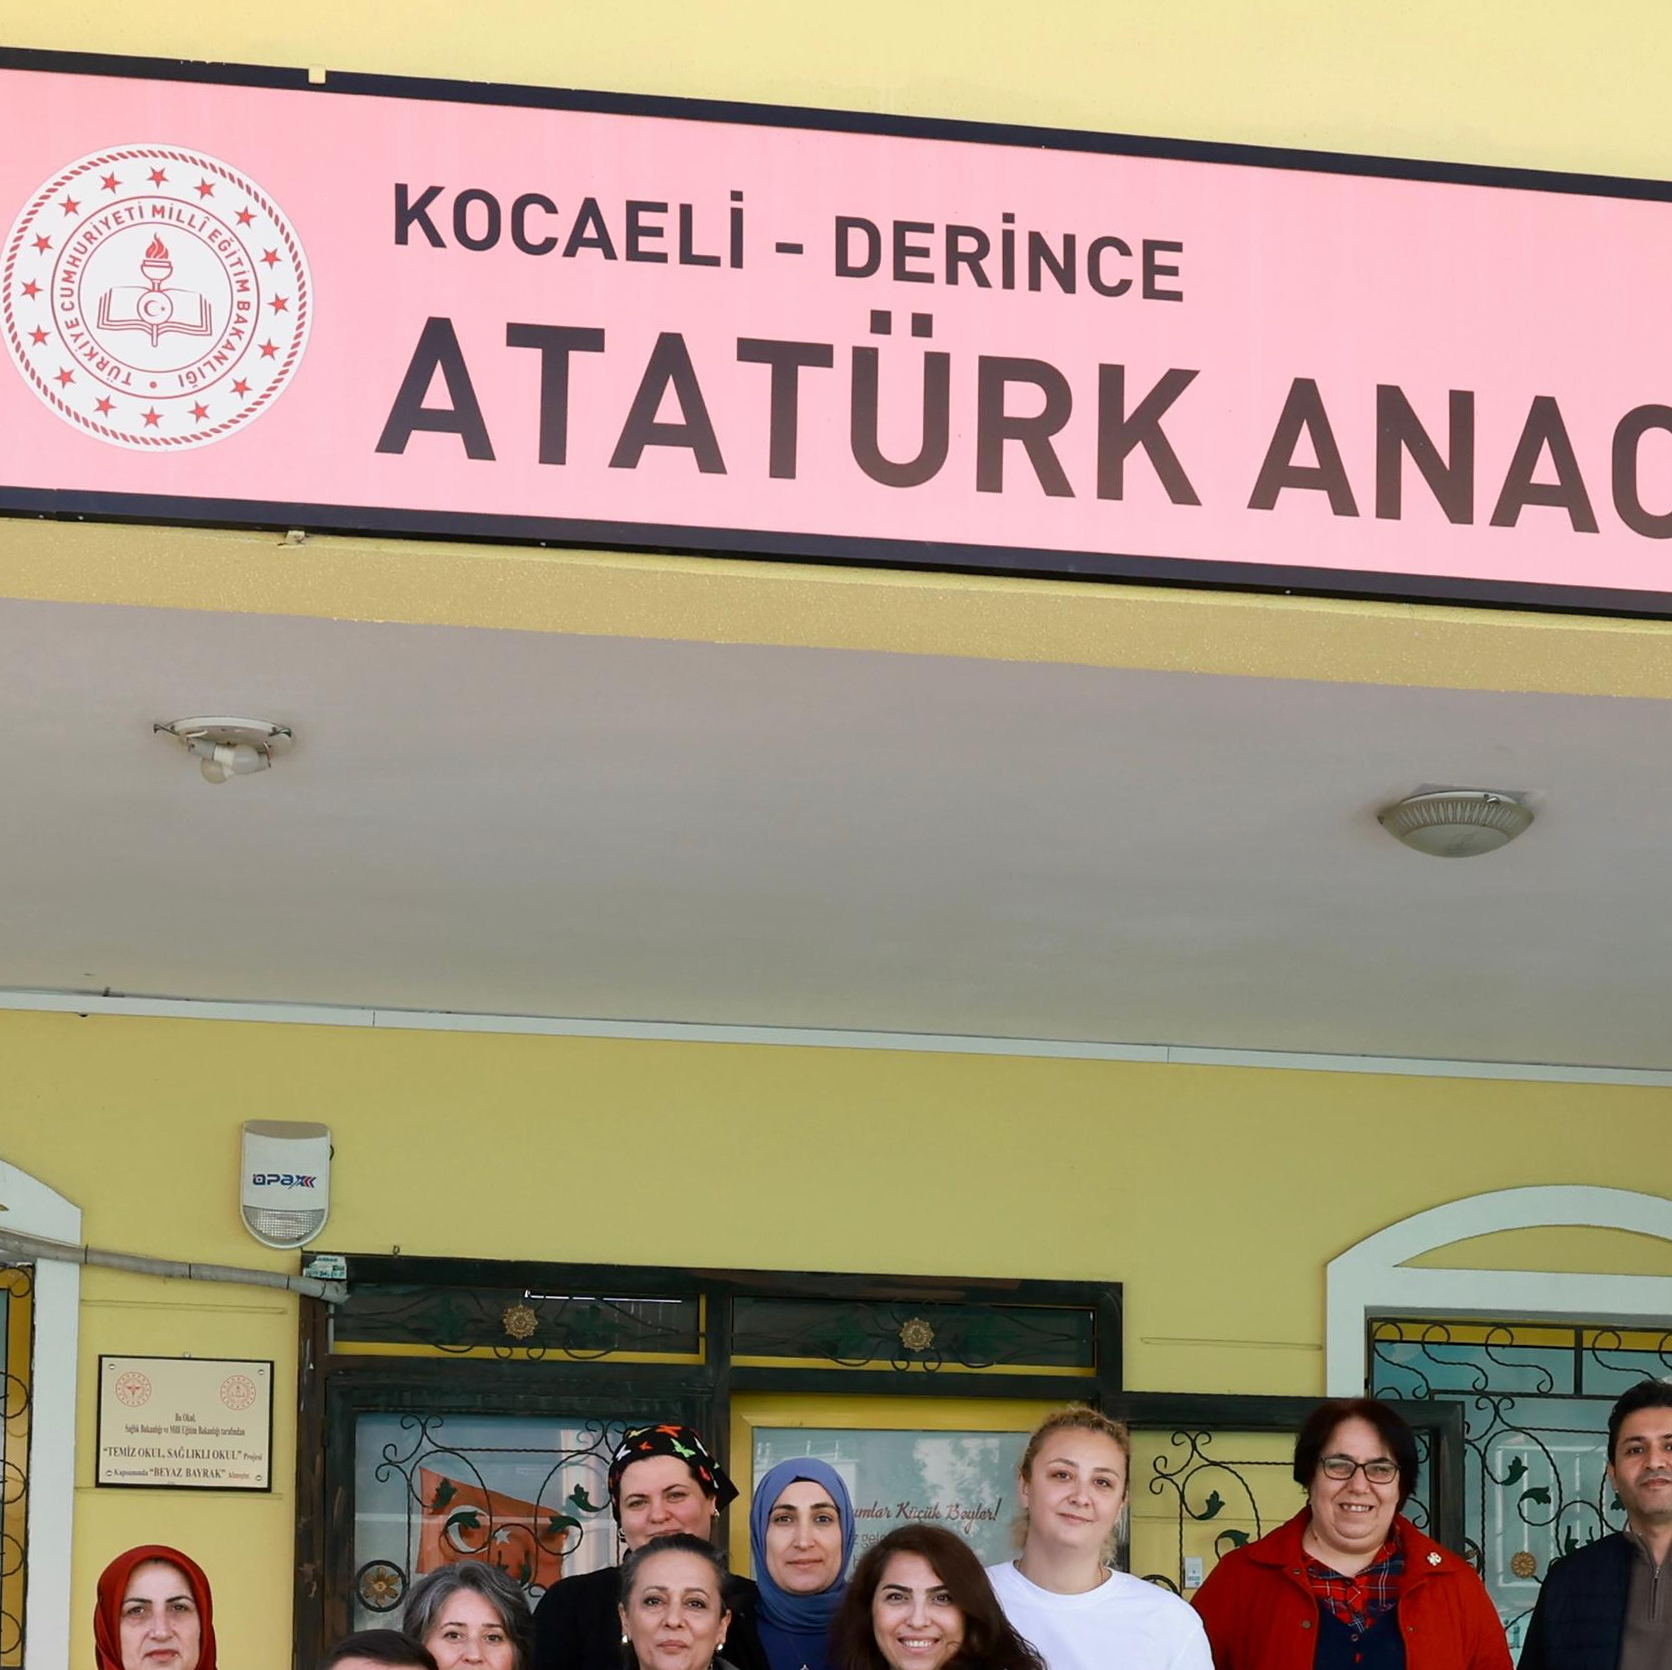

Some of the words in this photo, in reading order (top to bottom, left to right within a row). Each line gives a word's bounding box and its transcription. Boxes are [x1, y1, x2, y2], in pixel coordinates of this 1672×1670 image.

[60, 201, 144, 312] CUMHURİYETİ
[208, 228, 250, 293] EĞİTİM
[395, 183, 743, 268] KOCAELİ
[776, 243, 803, 254] -
[836, 211, 1182, 301] DERİNCE
[64, 317, 132, 386] TÜRKİYE
[178, 301, 251, 388] BAKANLIĞI
[376, 310, 1201, 505] ATATÜRK
[895, 1501, 941, 1523] Küçük
[946, 1498, 1002, 1534] Beyler!
